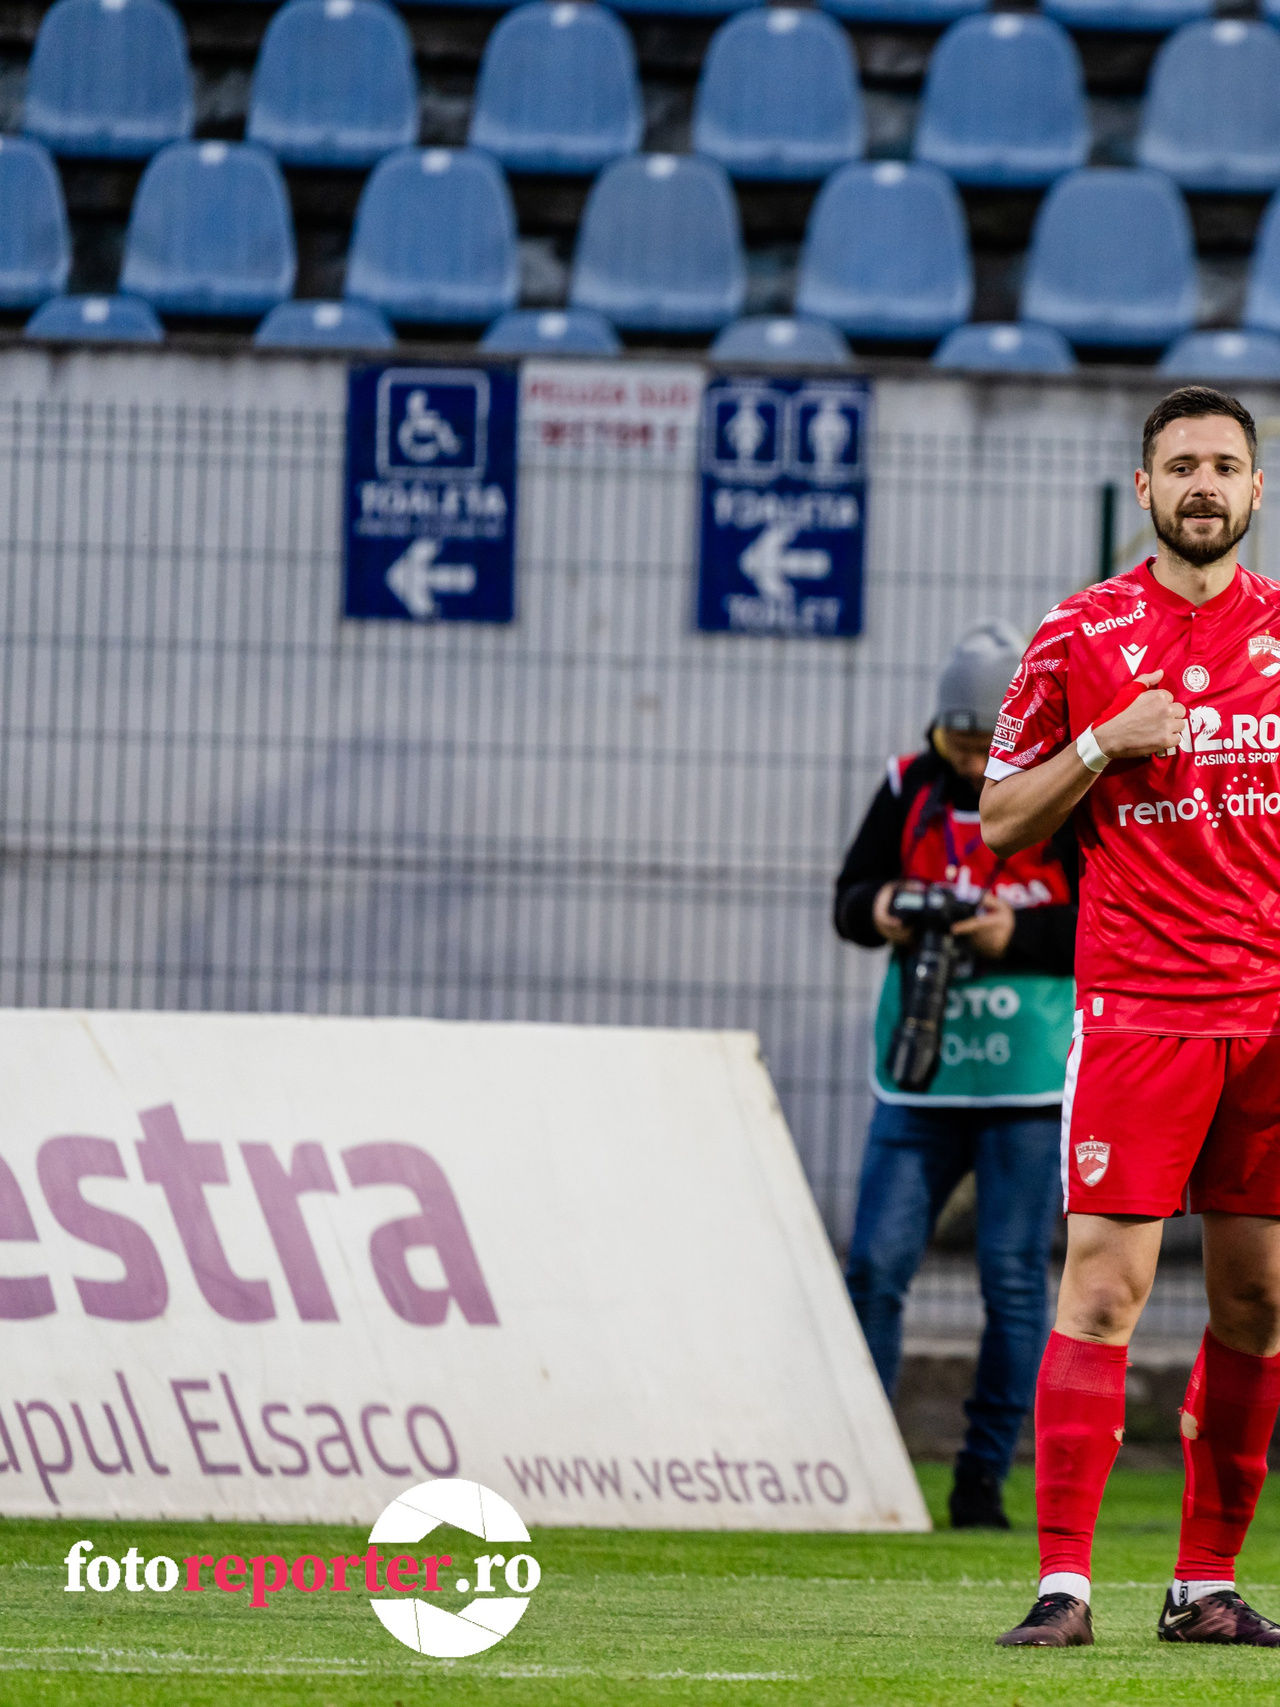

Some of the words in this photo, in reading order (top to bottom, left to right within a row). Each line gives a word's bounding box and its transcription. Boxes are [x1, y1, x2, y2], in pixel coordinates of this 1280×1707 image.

[1082, 606, 1146, 637] Beneva
[995, 726, 1016, 741] RESTI
[1194, 753, 1236, 767] CASINO
[1237, 752, 1246, 763] &
[170, 1372, 460, 1477] Elsaco
[504, 1449, 849, 1505] www.vestra.ro
